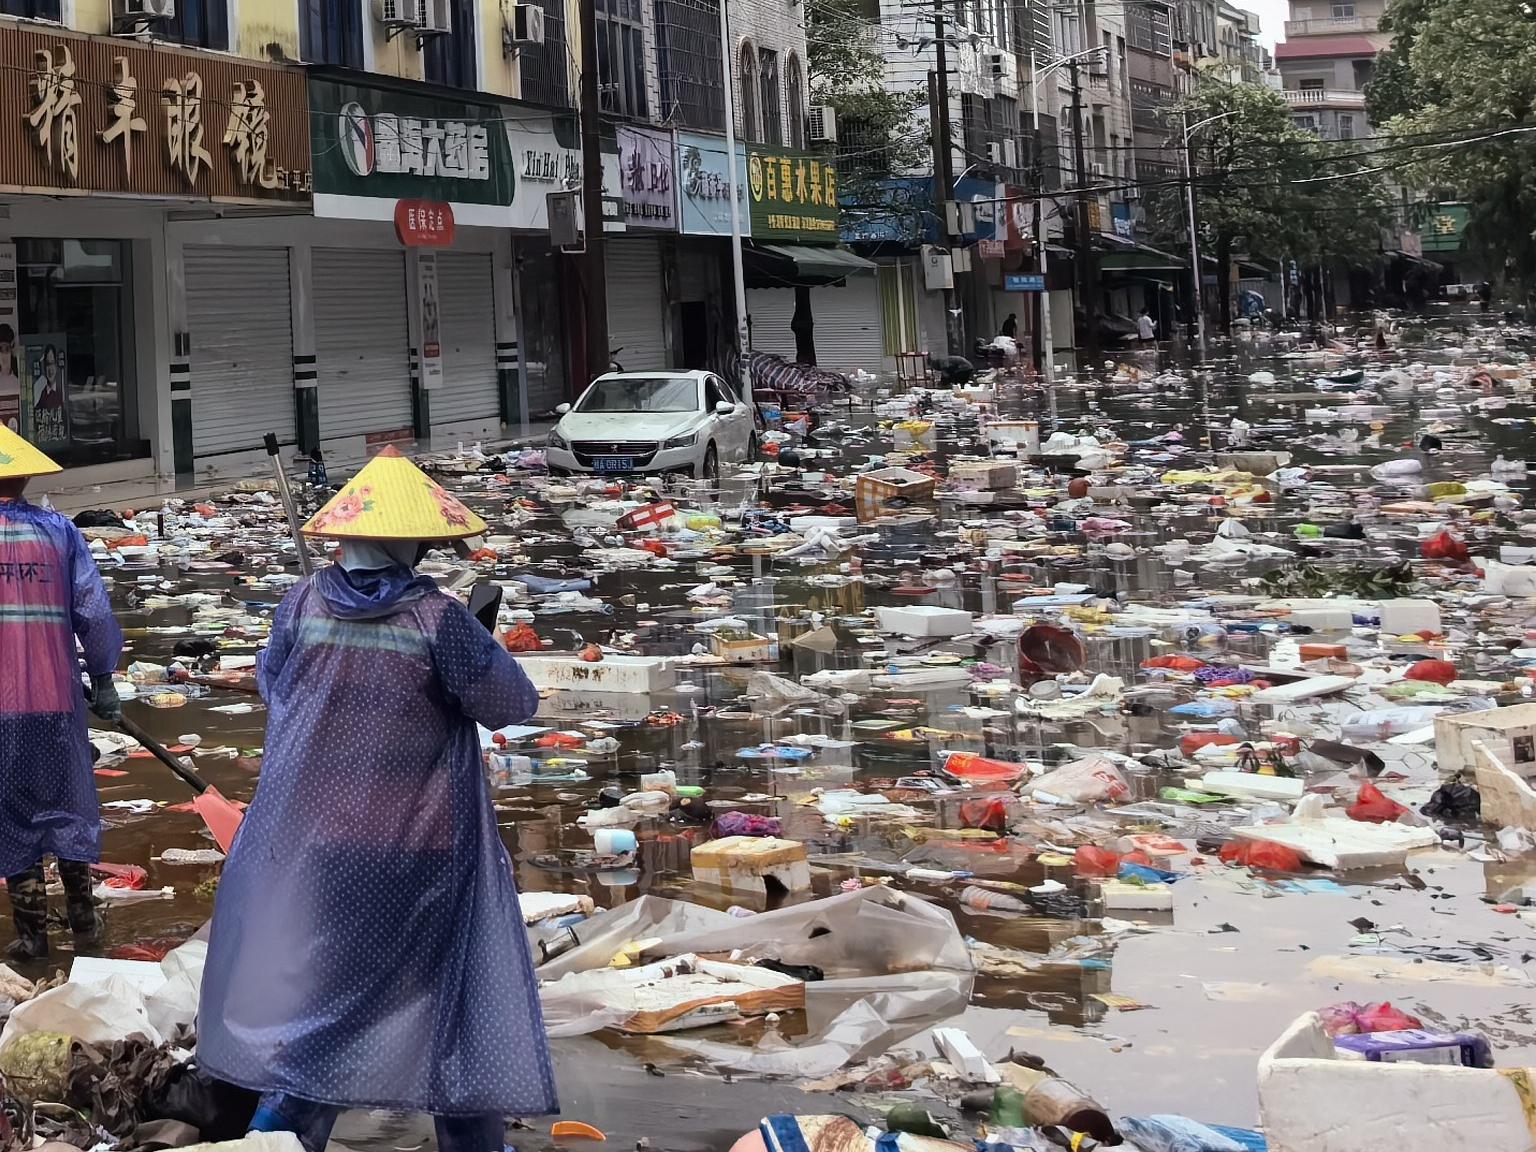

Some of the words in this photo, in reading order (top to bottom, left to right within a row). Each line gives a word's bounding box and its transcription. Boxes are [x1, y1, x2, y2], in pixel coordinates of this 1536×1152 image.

[22, 43, 278, 189] 精丰眼镜
[764, 156, 836, 207] 百惠水果店
[408, 207, 444, 231] 医保定点
